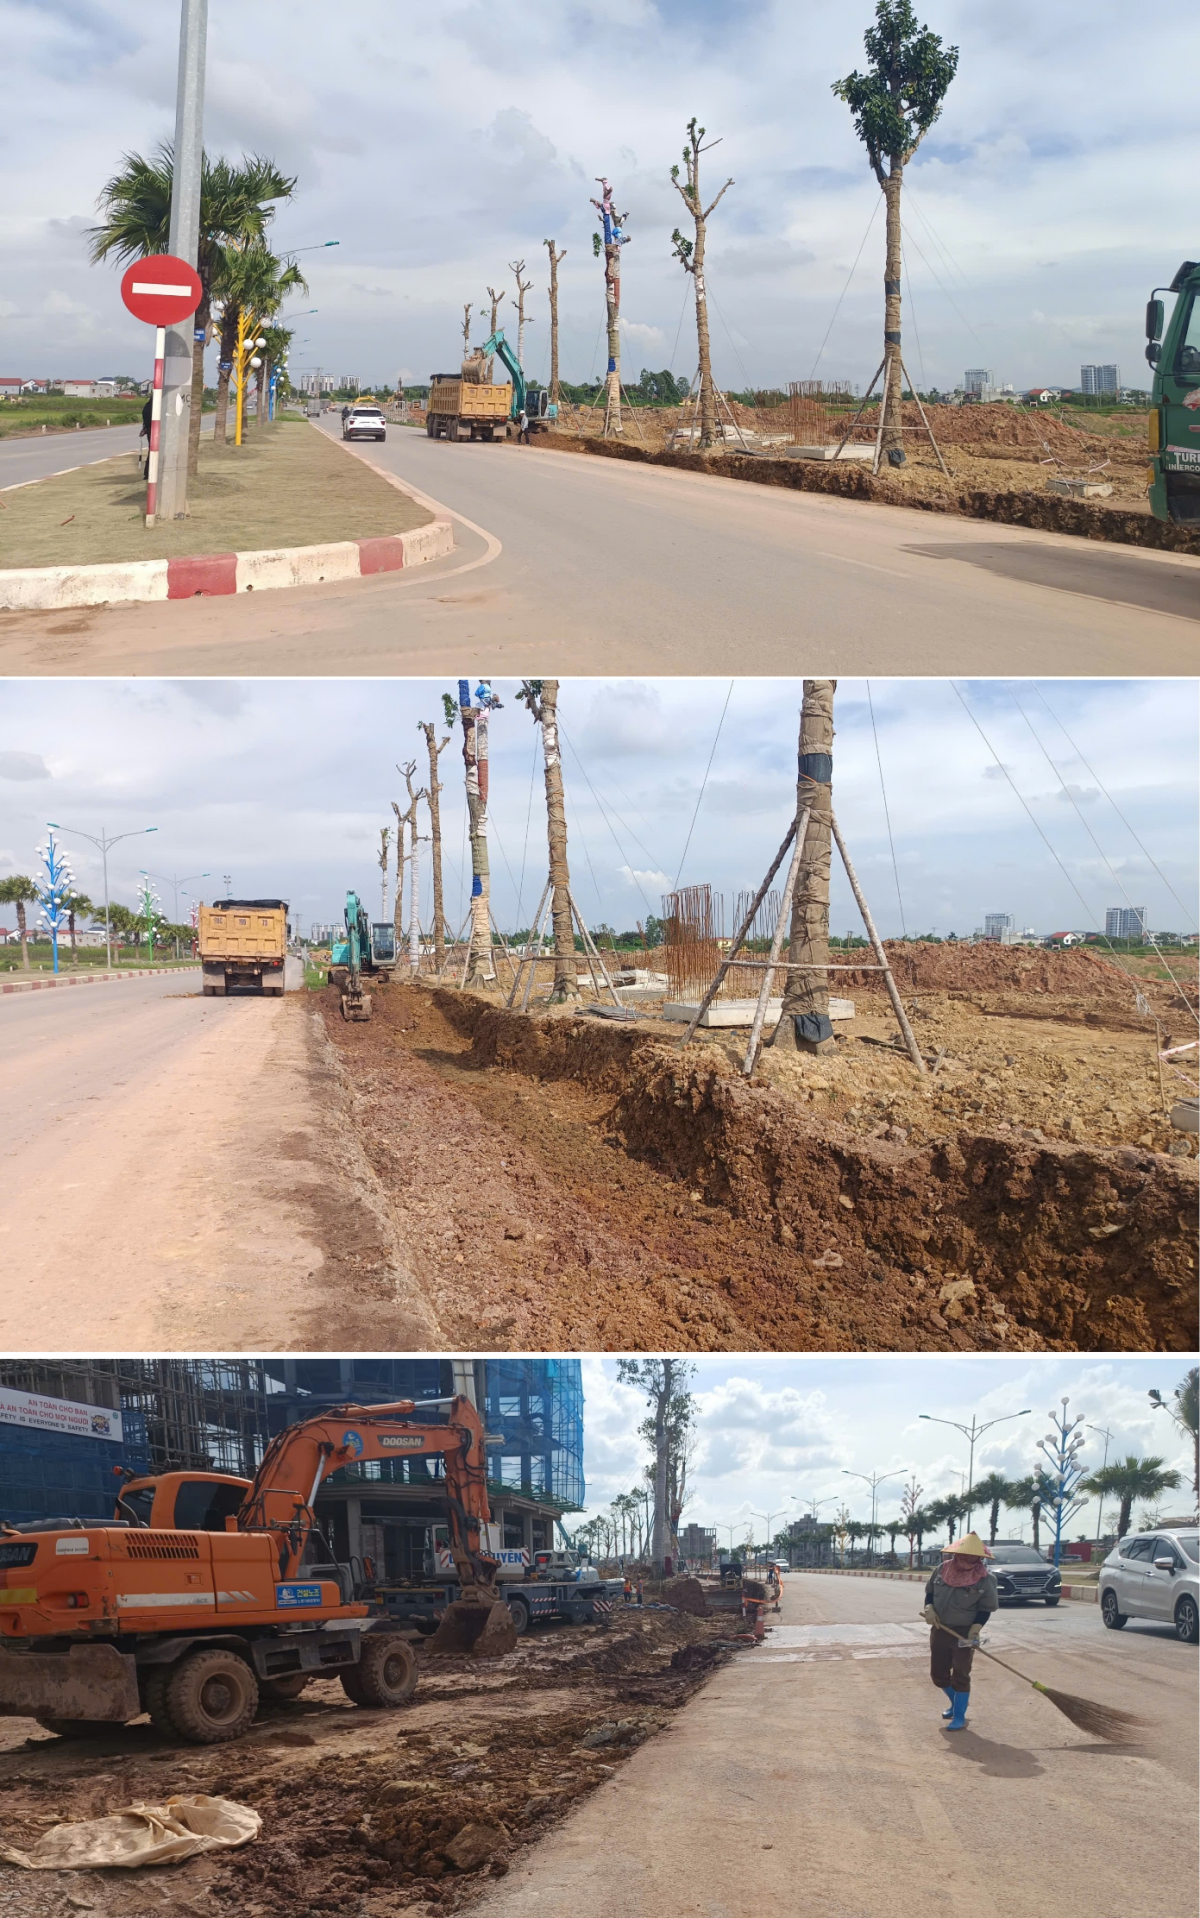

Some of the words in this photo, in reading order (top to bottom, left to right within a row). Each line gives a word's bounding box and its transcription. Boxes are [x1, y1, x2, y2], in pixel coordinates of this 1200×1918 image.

[1168, 463, 1200, 472] INTERCO
[7, 1404, 17, 1412] AN
[39, 1410, 54, 1419] CHO
[28, 1399, 37, 1407] AN
[58, 1404, 73, 1413] CHO
[0, 1412, 16, 1420] FETY
[67, 1423, 89, 1432] SAFETY
[382, 1437, 422, 1446] DOOSAN
[488, 1549, 522, 1563] UYÊN
